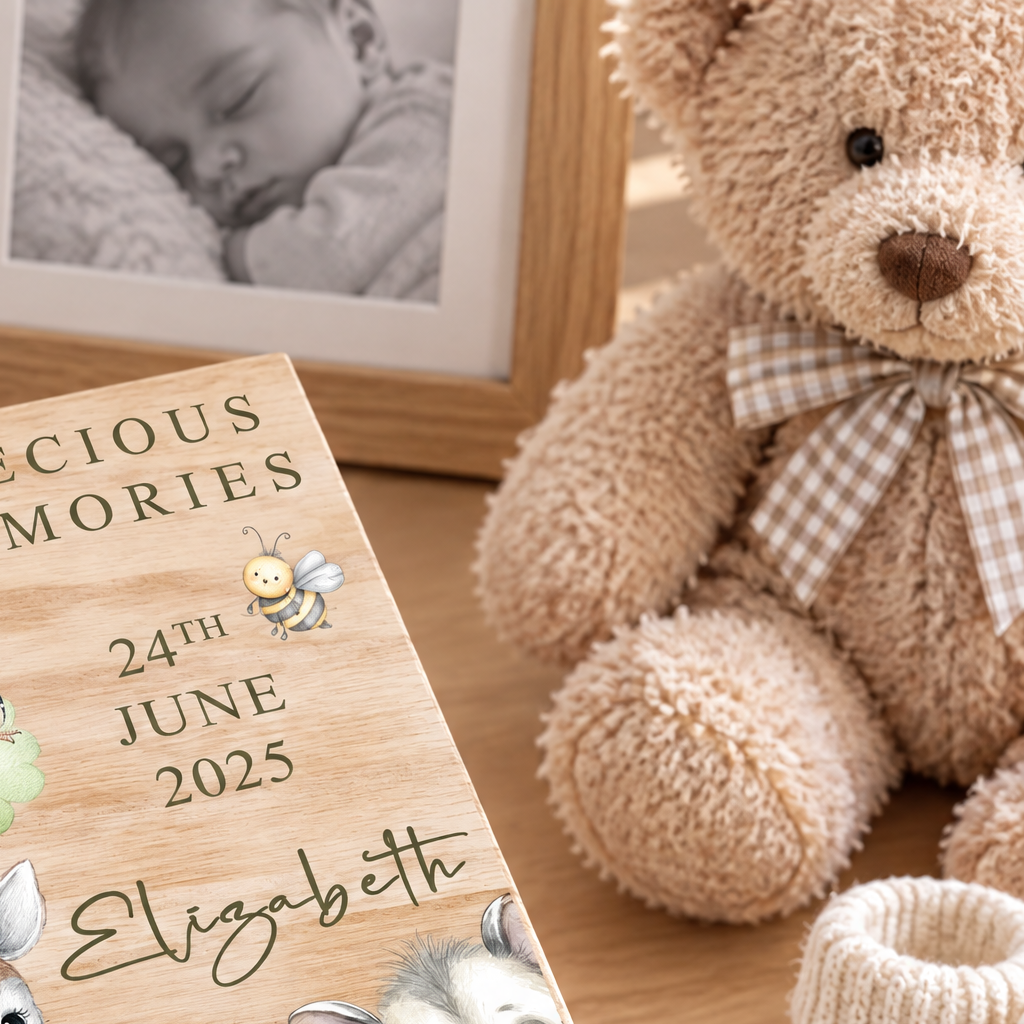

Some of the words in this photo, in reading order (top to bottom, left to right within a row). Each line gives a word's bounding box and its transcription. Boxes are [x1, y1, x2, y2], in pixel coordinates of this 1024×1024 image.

[108, 613, 229, 678] 24TH
[114, 673, 286, 746] JUNE
[155, 739, 294, 808] 2025
[60, 825, 468, 988] Elizabeth
